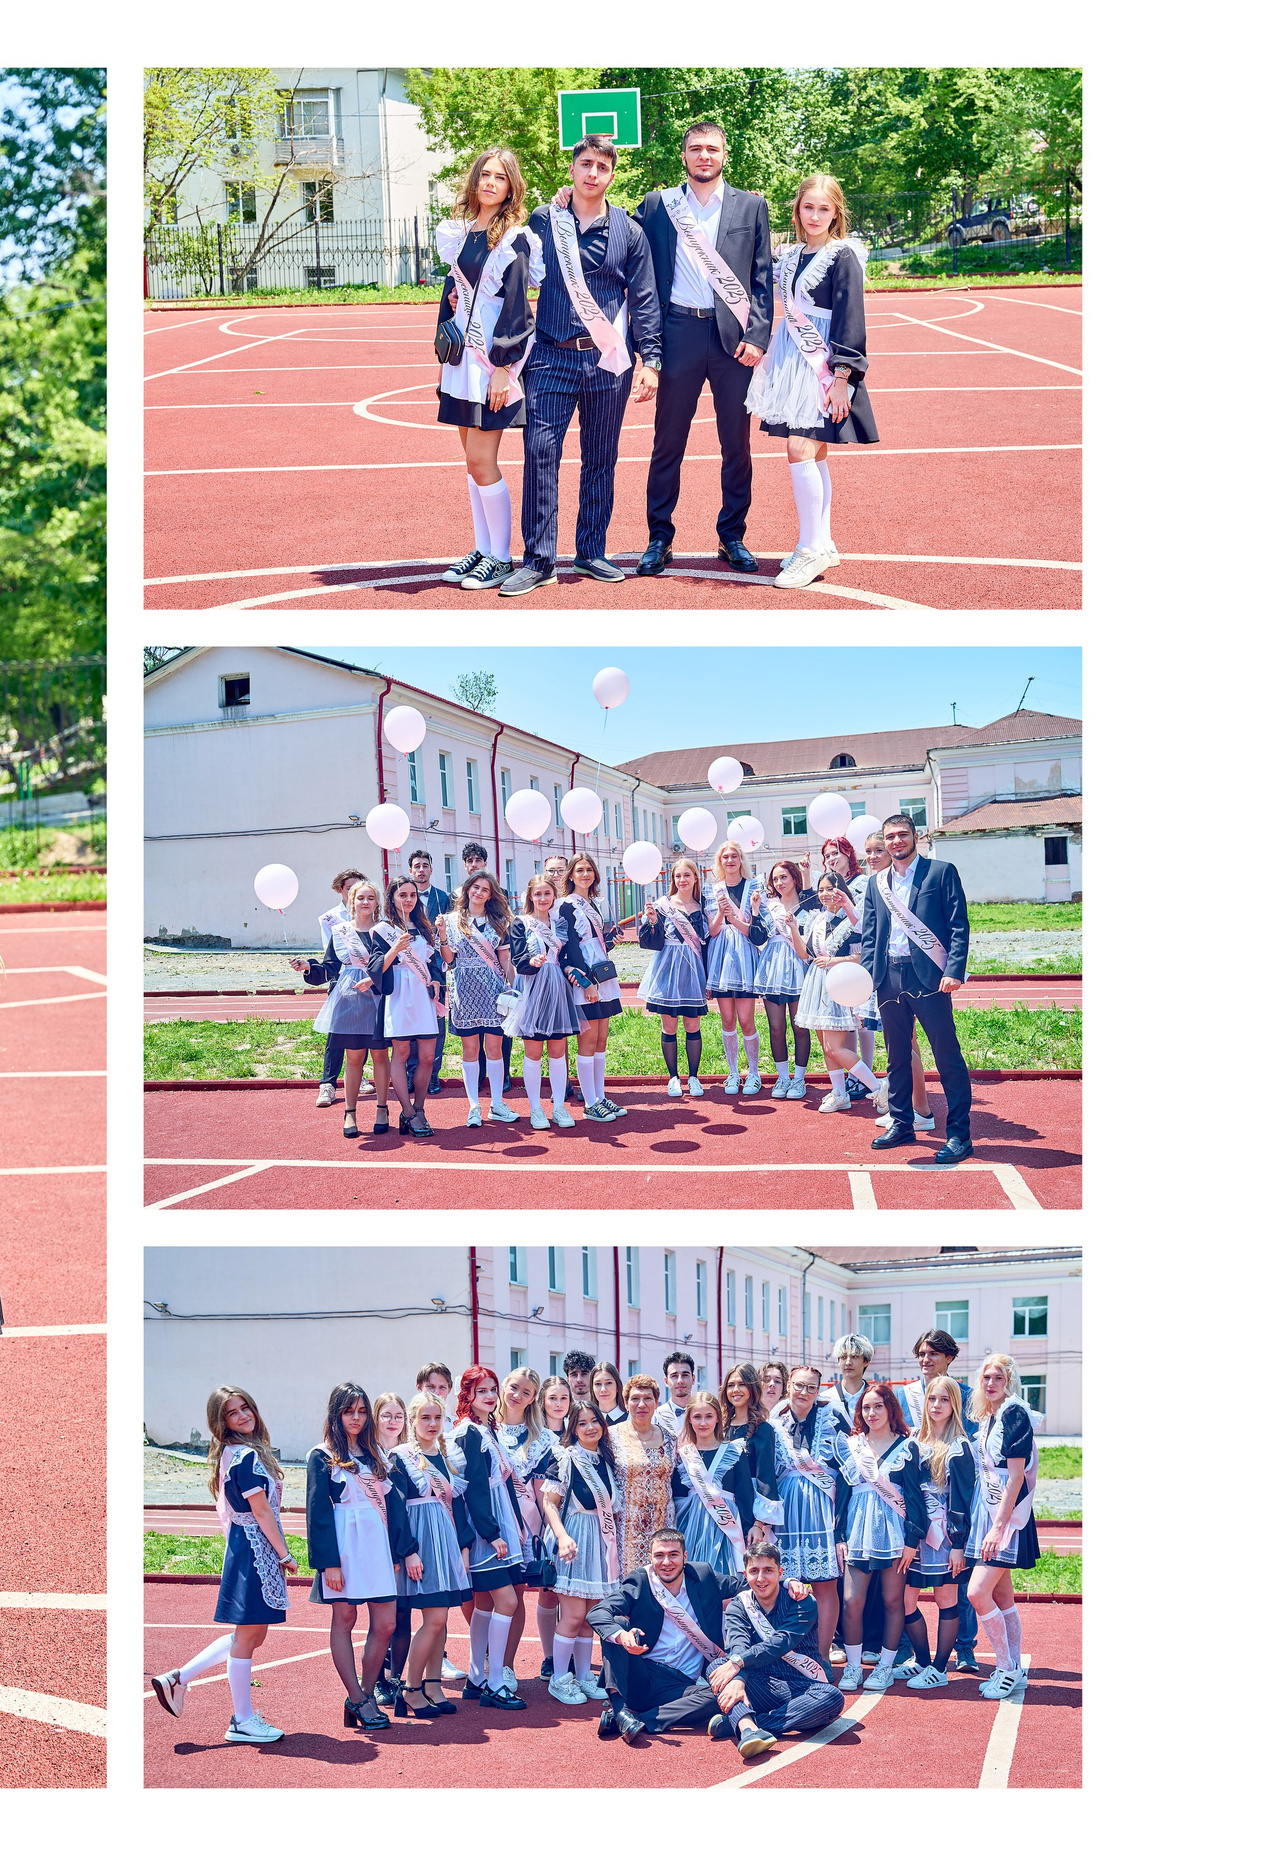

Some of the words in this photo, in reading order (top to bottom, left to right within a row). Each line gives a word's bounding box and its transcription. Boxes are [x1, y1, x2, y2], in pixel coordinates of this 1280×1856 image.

[676, 216, 720, 276] Выпускник
[715, 276, 748, 305] 2025
[574, 289, 606, 322] 2025
[794, 325, 828, 353] 2025
[912, 928, 941, 950] 2025
[602, 1511, 615, 1536] 2025
[712, 1503, 736, 1527] 2025
[800, 1657, 822, 1680] 2025
